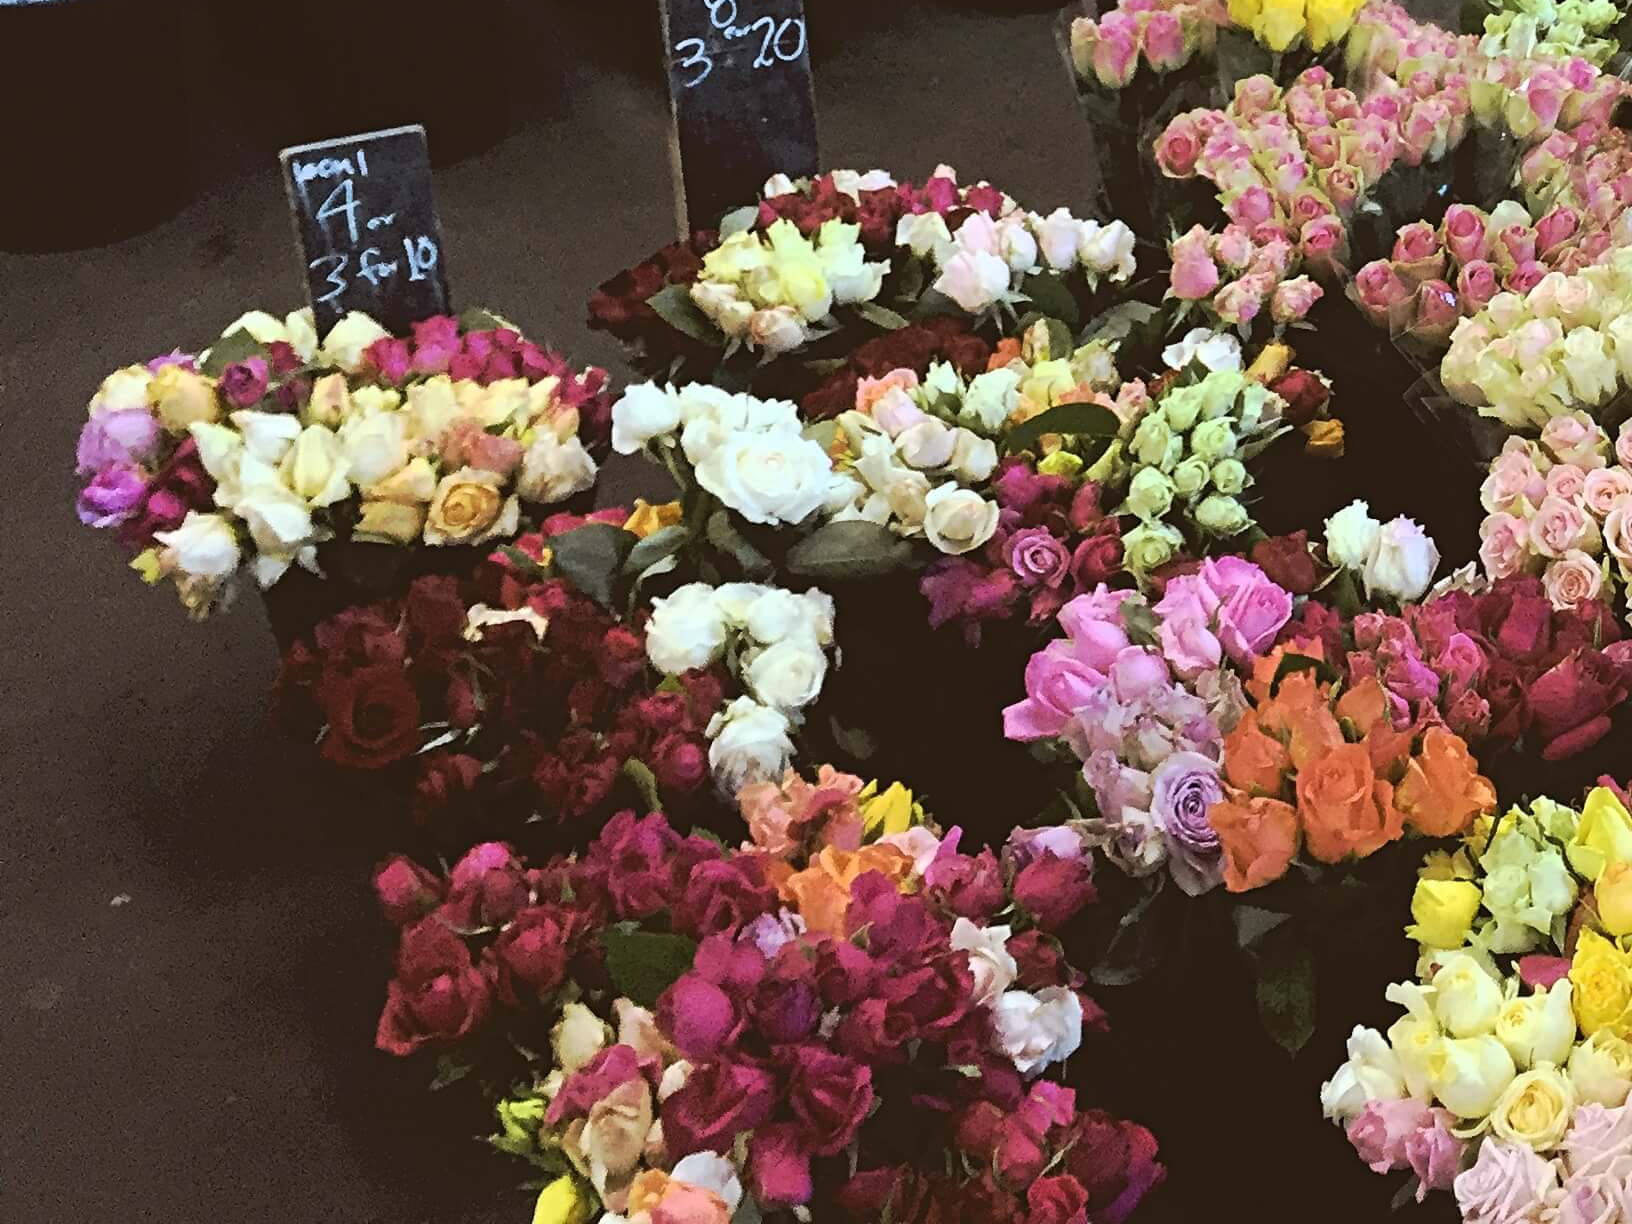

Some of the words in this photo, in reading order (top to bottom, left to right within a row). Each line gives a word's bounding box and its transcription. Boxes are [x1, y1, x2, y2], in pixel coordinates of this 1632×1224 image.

[674, 37, 713, 88] 3
[751, 16, 806, 69] 20
[315, 178, 362, 244] 4
[309, 252, 348, 303] 3
[403, 234, 439, 282] 10
